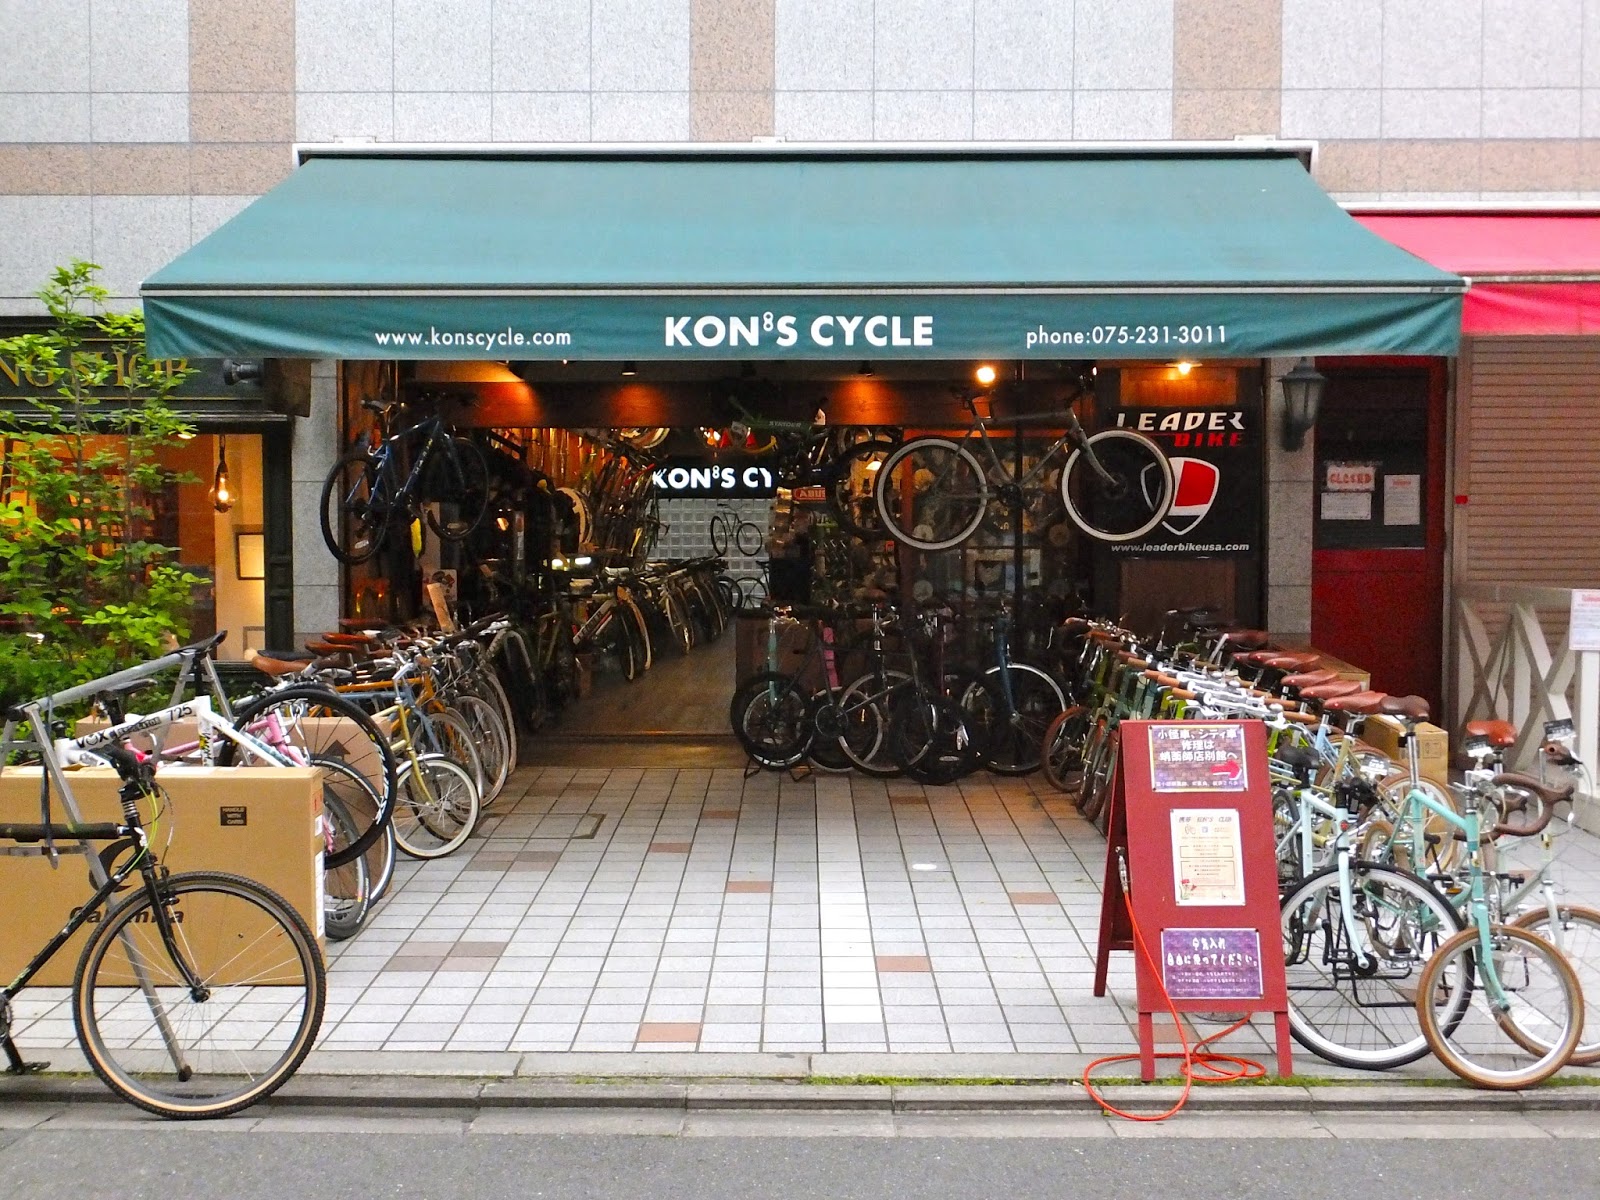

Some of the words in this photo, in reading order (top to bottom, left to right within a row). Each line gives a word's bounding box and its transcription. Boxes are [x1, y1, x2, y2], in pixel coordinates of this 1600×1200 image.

[374, 326, 572, 350] www.konscycle.com
[810, 315, 934, 347] CYCLE
[1026, 325, 1226, 348] phone:075-231-3011
[1174, 433, 1241, 447] BIKE
[1111, 543, 1250, 552] www.leaderbikeusa.com
[166, 705, 192, 721] 725
[1181, 740, 1215, 750] 修理は
